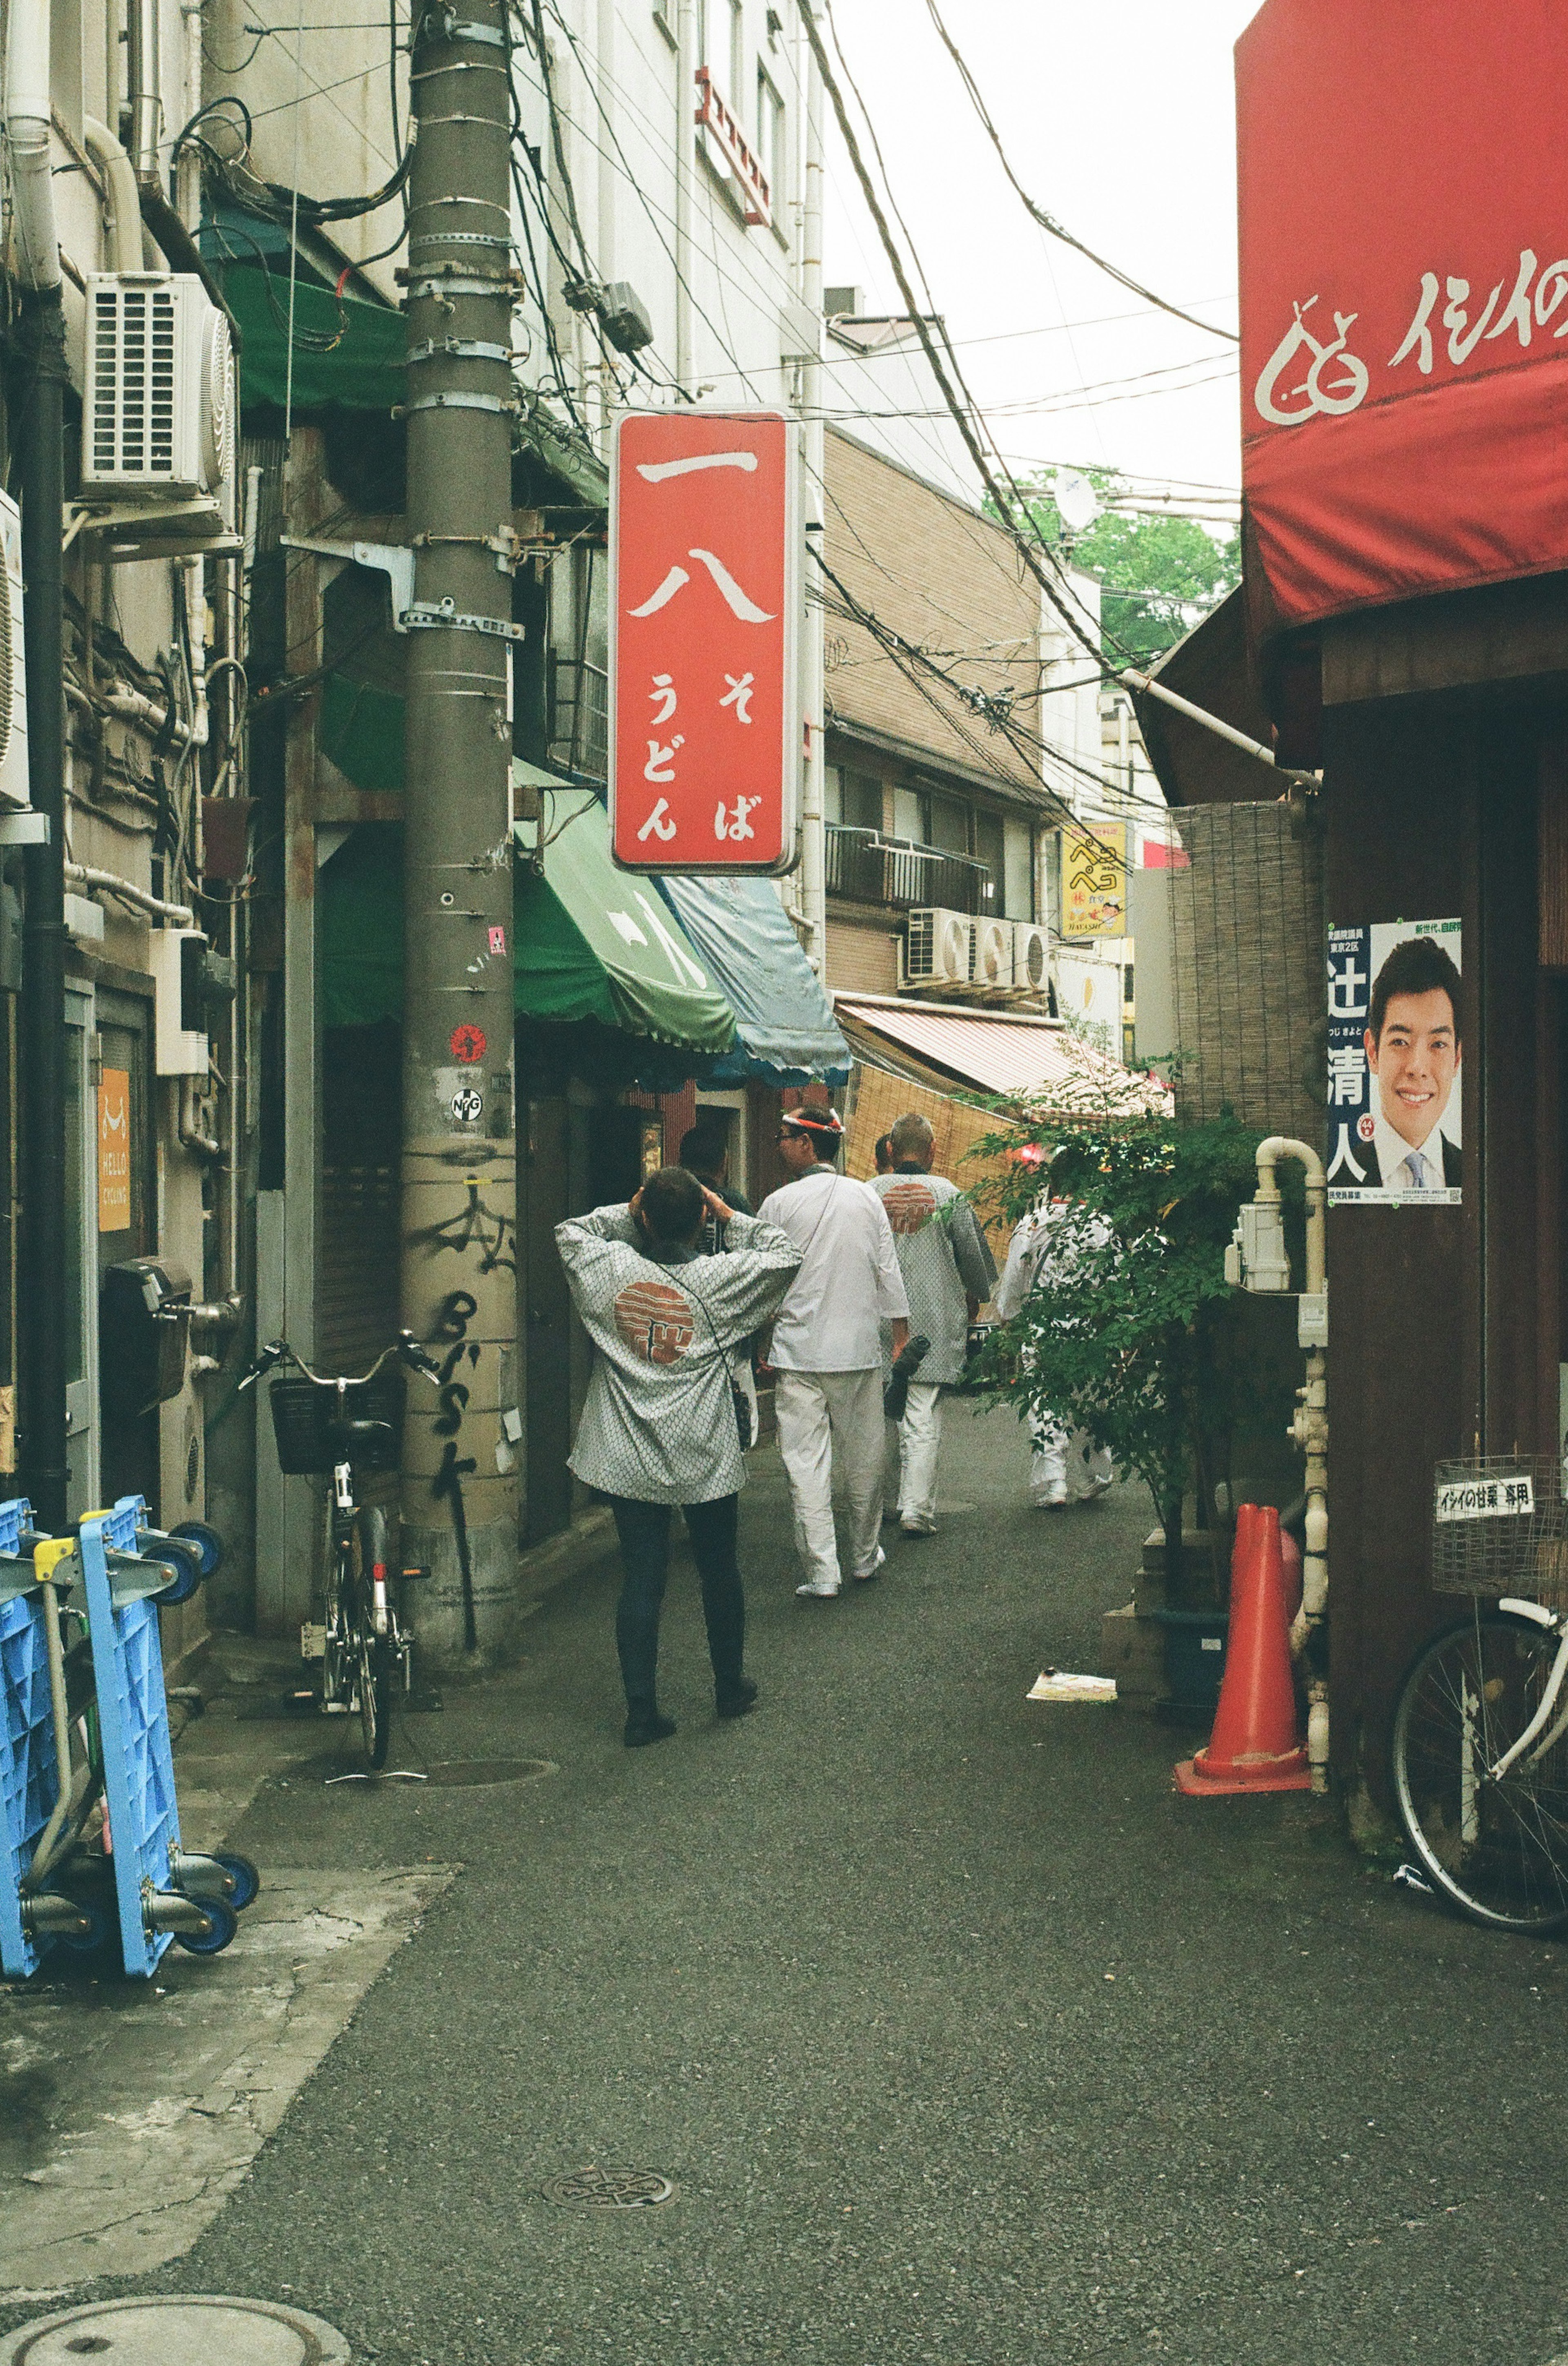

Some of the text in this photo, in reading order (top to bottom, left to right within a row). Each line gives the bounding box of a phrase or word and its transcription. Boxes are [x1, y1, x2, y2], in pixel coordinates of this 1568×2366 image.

[627, 452, 776, 623] 一八
[638, 674, 684, 841] うどん
[715, 672, 761, 841] そば
[1330, 941, 1359, 953] 東京2区
[103, 1152, 126, 1175] HELLO
[1441, 1483, 1529, 1512] イシイの甘栗 専用
